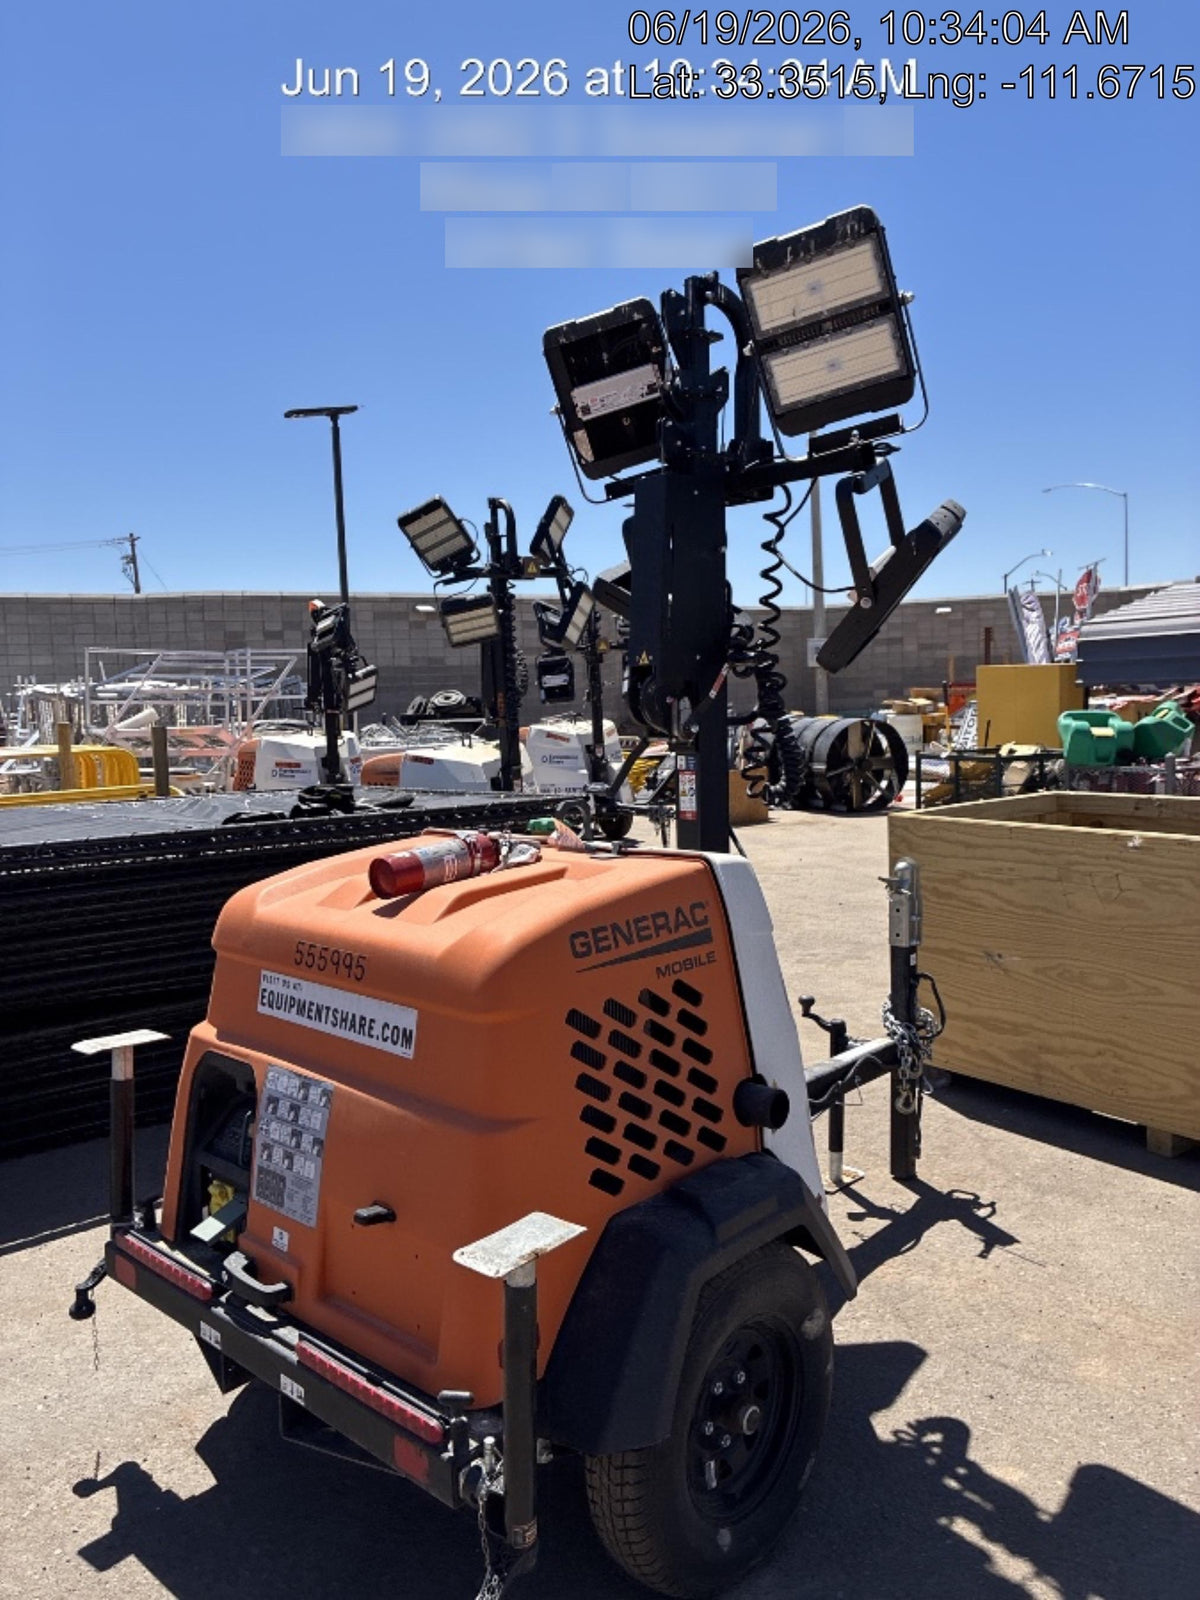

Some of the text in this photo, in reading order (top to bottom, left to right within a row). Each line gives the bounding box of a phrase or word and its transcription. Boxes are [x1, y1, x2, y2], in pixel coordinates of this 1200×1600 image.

[569, 901, 709, 959] GENERAC
[294, 941, 367, 981] 555995
[655, 951, 717, 979] MOBILE
[260, 988, 413, 1050] EQUIPMENTSHARE.COM
